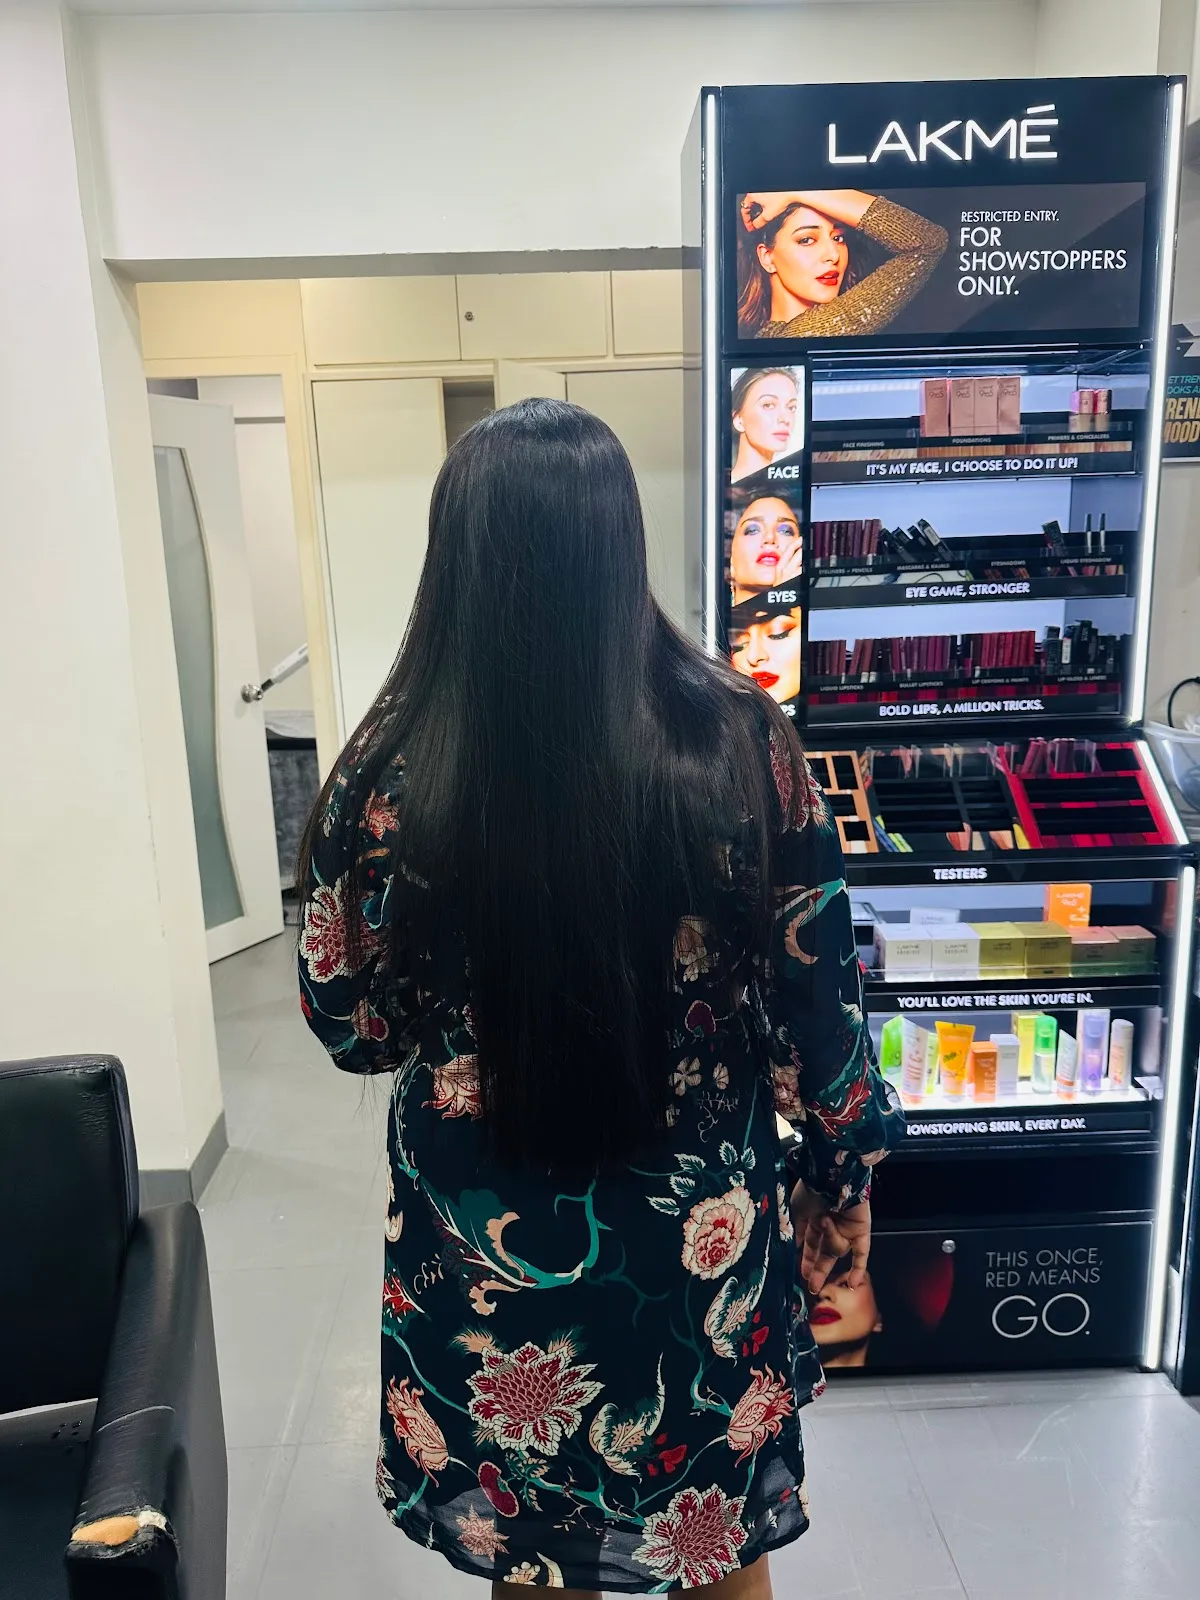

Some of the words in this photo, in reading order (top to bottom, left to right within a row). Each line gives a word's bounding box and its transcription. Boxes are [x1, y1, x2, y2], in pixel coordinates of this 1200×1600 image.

[828, 104, 1059, 164] LAKMÉ
[961, 211, 1021, 223] RESTRICTED
[1024, 210, 1060, 222] ENTRY.
[960, 227, 1002, 247] FOR
[959, 250, 1127, 271] SHOWSTOPPERS
[958, 275, 1020, 296] ONLY.
[1167, 375, 1179, 384] ET
[1167, 386, 1192, 394] OOKS
[1165, 397, 1200, 419] REN
[768, 466, 800, 479] FACE
[866, 464, 887, 476] IT'S
[888, 463, 908, 475] MY
[909, 461, 942, 475] FACE,
[945, 462, 950, 472] I
[951, 460, 1003, 473] CHOOSE
[1004, 459, 1022, 471] TO
[1024, 458, 1045, 470] DO
[1046, 458, 1057, 469] IT
[1058, 457, 1078, 469] UP!
[768, 590, 797, 603] EYES
[906, 587, 928, 598] EYE
[929, 585, 967, 598] GAME,
[969, 582, 1031, 596] STRONGER
[780, 704, 797, 717] PS
[880, 705, 911, 716] BOLD
[912, 703, 941, 715] LIPS,
[942, 703, 953, 713] A
[953, 701, 1001, 714] MILLION
[1002, 699, 1045, 712] TRICKS.
[933, 868, 988, 880] TESTERS
[897, 996, 940, 1008] YOU'LL
[941, 995, 973, 1008] LOVE
[973, 995, 998, 1007] THE
[998, 994, 1030, 1006] SKIN
[1031, 993, 1076, 1005] YOU'RE
[1077, 992, 1094, 1003] IN.
[907, 1121, 988, 1136] OWSTOPPING
[989, 1120, 1024, 1133] SKIN,
[1025, 1118, 1060, 1131] EVERY
[1061, 1117, 1087, 1129] DAY.
[985, 1250, 1029, 1268] THIS
[1036, 1247, 1103, 1266] ONCE,
[985, 1271, 1021, 1288] RED
[1027, 1267, 1101, 1285] MEANS
[992, 1292, 1091, 1339] GO.
